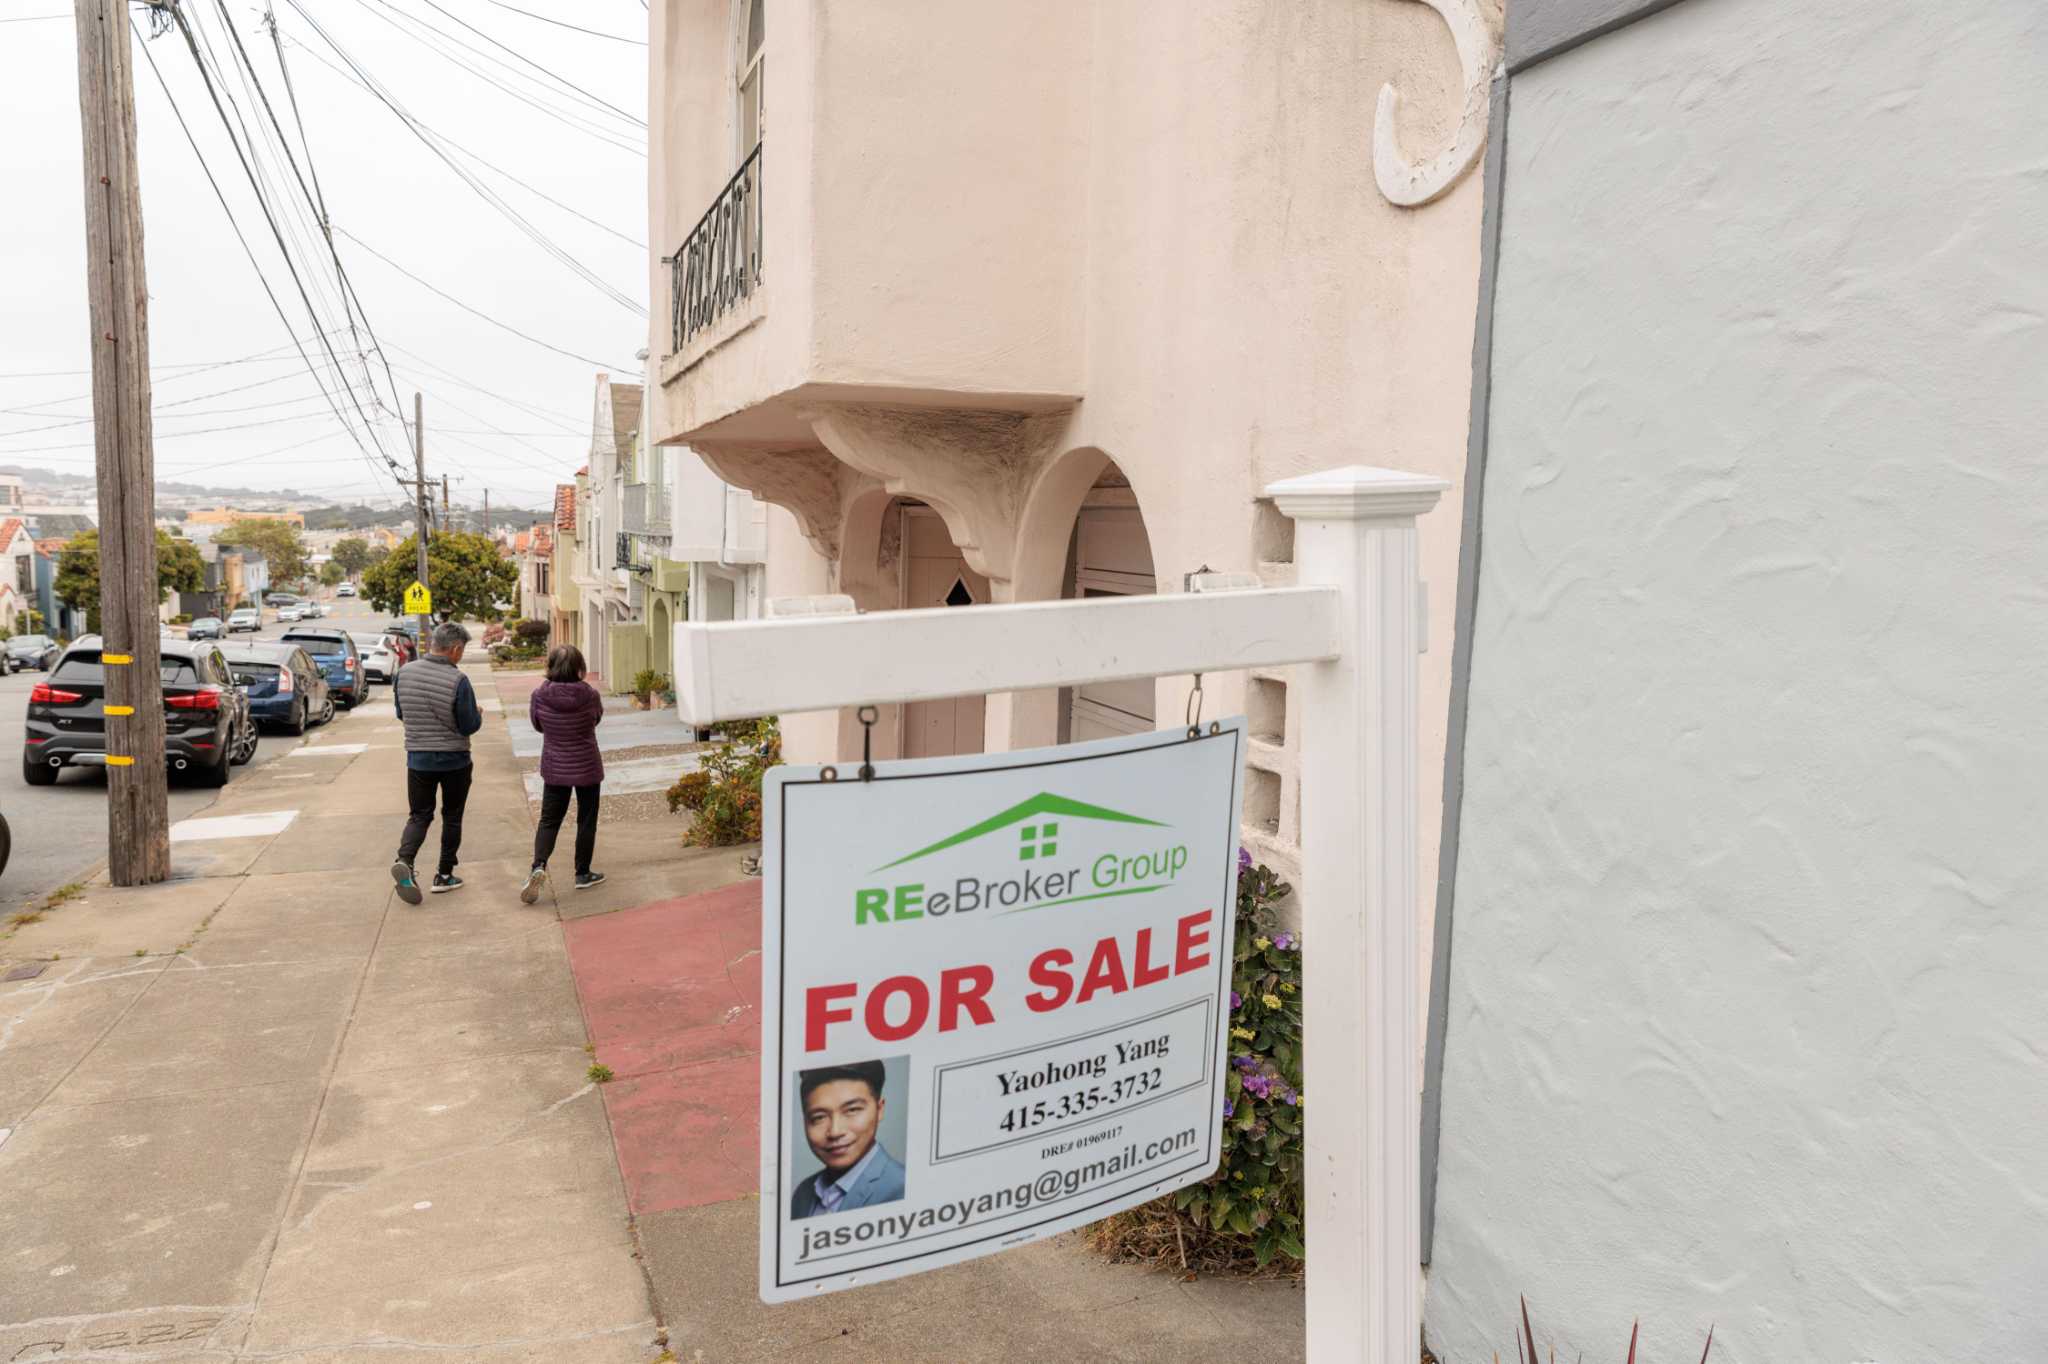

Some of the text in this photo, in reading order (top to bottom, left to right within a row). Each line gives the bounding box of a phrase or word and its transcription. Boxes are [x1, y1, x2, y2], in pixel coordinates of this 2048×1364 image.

[855, 844, 1188, 926] REeBroker Group
[804, 909, 1213, 1053] FOR SALE
[997, 1033, 1170, 1098] Yaohong Yang
[1000, 1067, 1163, 1133] 415-335-3732
[1041, 1126, 1123, 1160] DRE# 01969117
[798, 1126, 1196, 1259] jasonyaoyang@gmail.com
